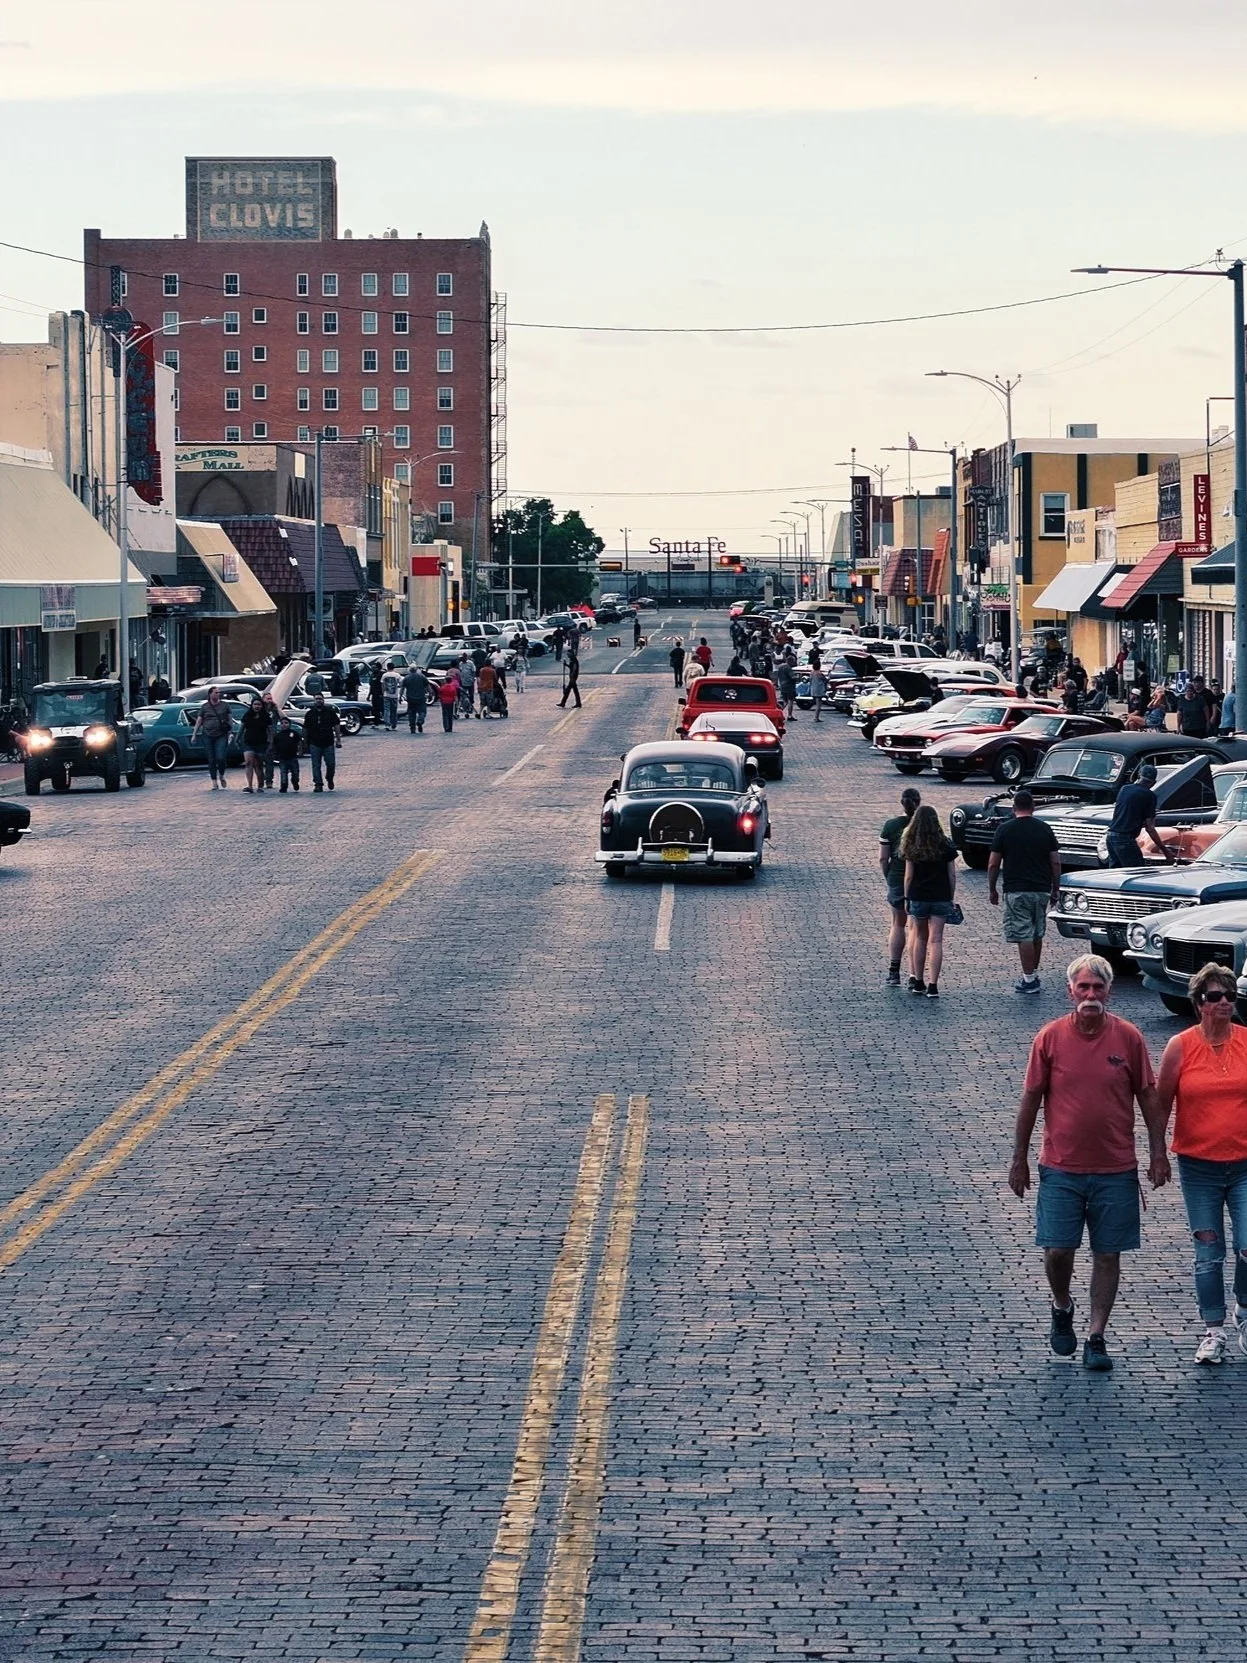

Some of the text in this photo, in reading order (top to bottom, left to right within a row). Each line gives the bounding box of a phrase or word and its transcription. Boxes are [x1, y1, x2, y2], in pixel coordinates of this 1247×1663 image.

[211, 170, 314, 195] HOTEL
[210, 203, 314, 228] CLOVIS
[174, 449, 238, 462] RAFTERS
[1197, 476, 1208, 540] LEVINES
[649, 536, 727, 554] Santa Fe
[1178, 546, 1208, 554] GARDENS
